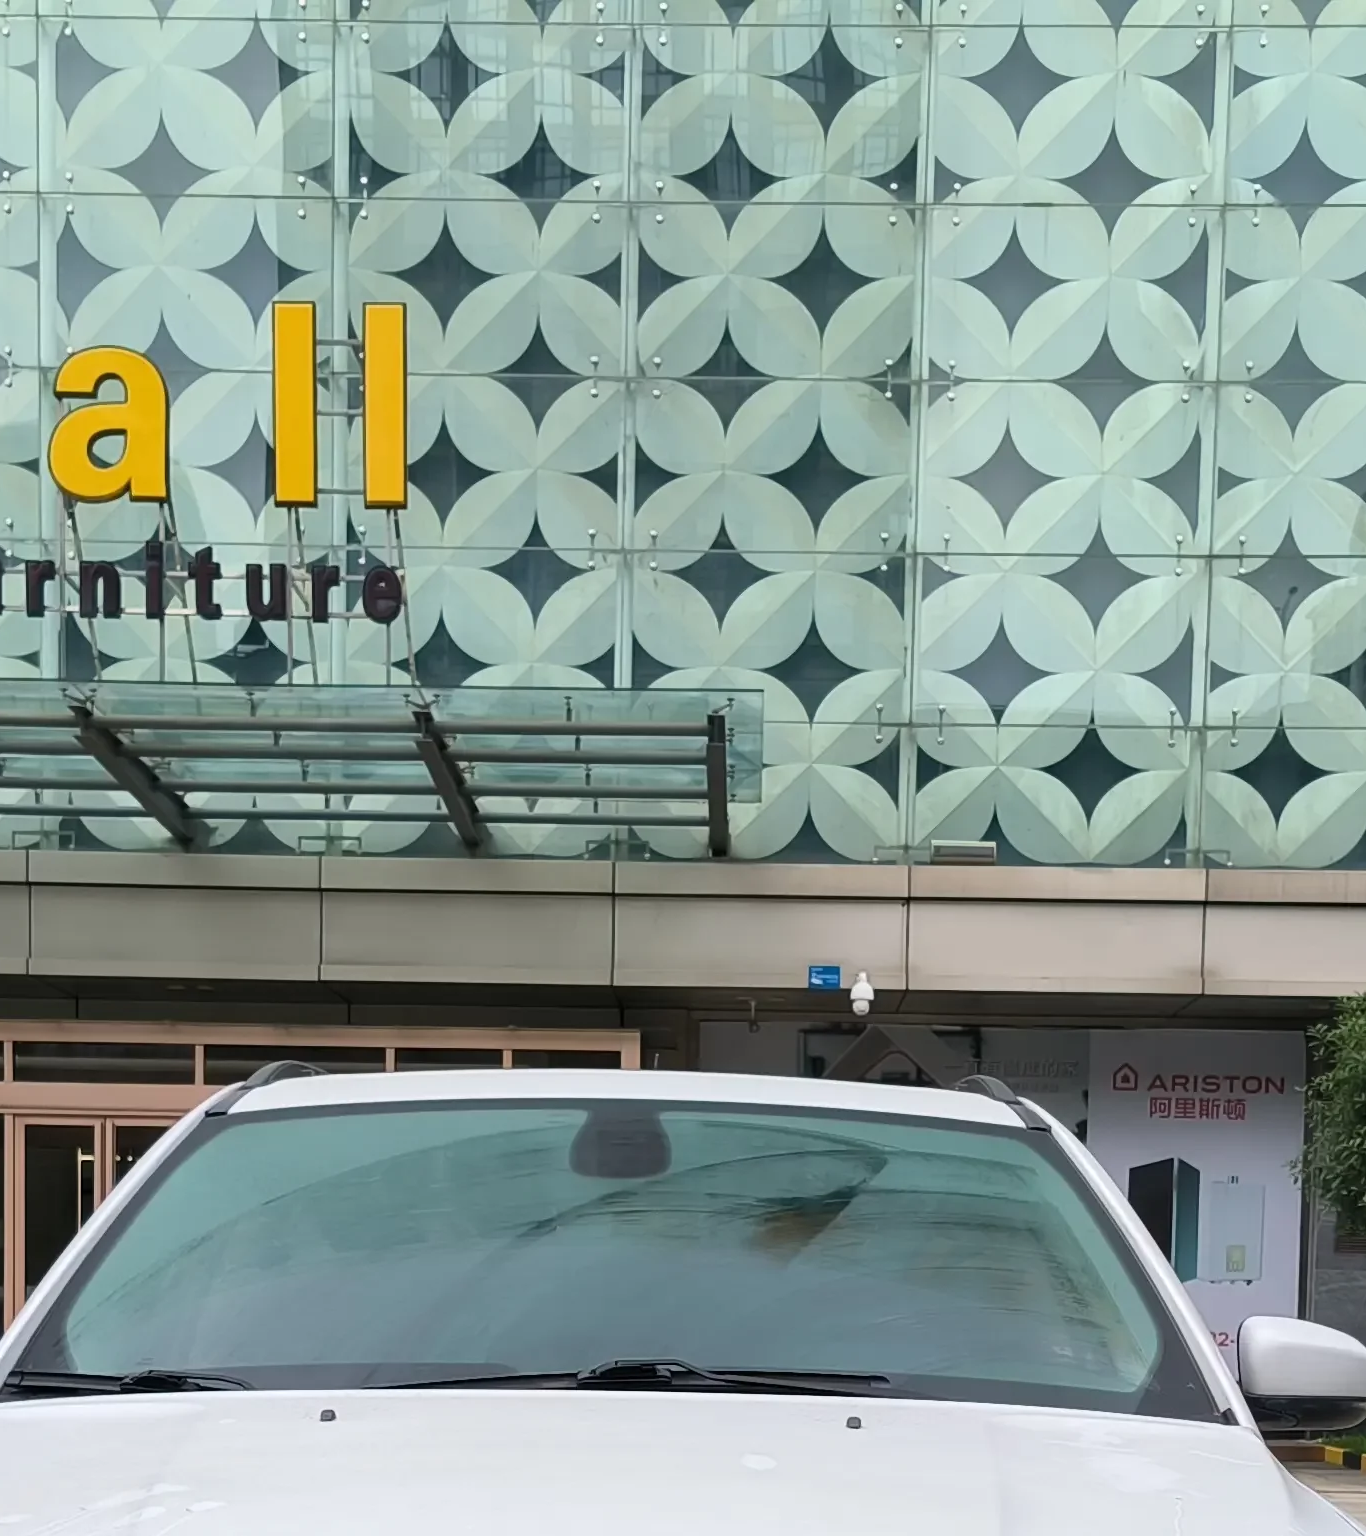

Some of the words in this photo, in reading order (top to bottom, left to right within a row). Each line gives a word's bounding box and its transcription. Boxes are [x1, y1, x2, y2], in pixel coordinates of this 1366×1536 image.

[1147, 1074, 1286, 1095] ARISTON
[1149, 1097, 1247, 1121] 阿里斯顿
